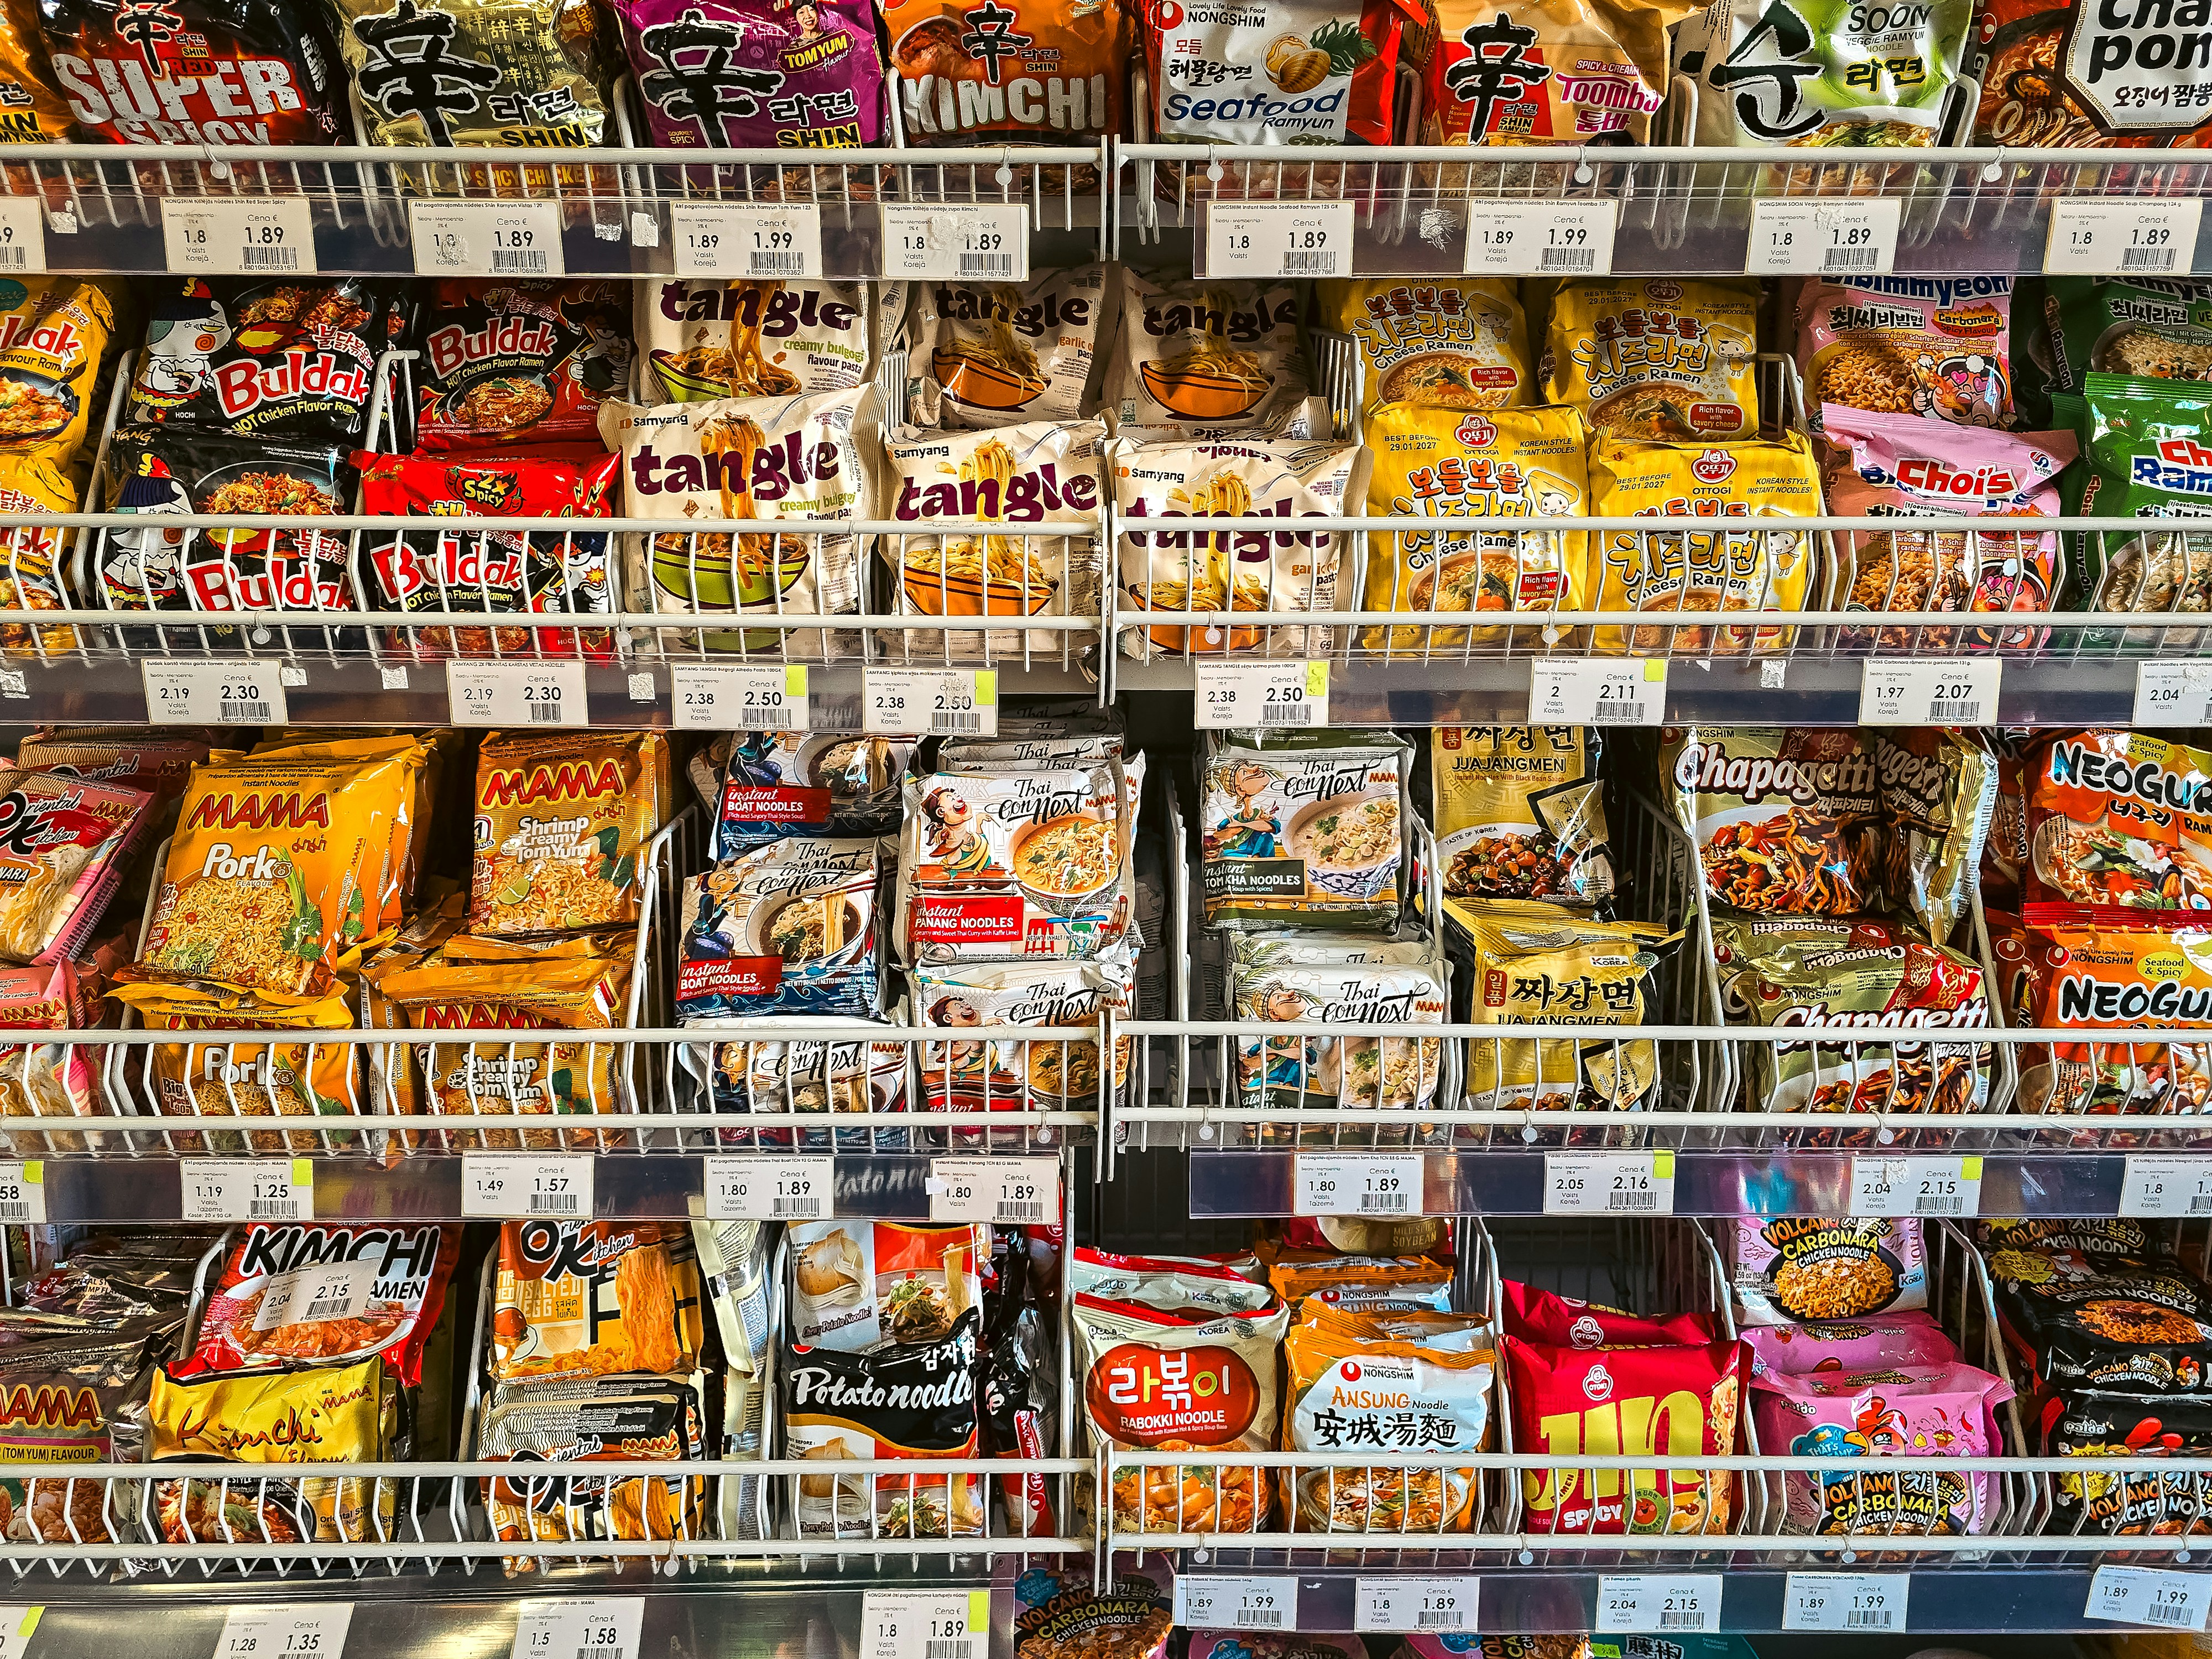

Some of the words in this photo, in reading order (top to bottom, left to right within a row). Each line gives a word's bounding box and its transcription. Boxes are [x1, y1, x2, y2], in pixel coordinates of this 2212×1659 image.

[1188, 11, 1266, 28] NONGSHIM
[1848, 3, 1934, 34] SOON
[962, 2, 1032, 85] 辛
[1846, 33, 1881, 47] VEGGIE
[1883, 30, 1924, 43] RAMYUN
[182, 47, 208, 57] SHIN
[1175, 39, 1203, 54] 모듬
[1866, 43, 1903, 54] NOODLE
[167, 58, 219, 75] RED
[1026, 62, 1057, 72] SHIN
[1169, 59, 1253, 87] 해물탕면
[1846, 55, 1927, 93] 라면
[53, 54, 305, 124] SUPER
[1555, 72, 1660, 113] Toomba
[2112, 85, 2169, 108] 오징어
[904, 74, 1105, 134] KIMCHI
[1164, 88, 1346, 121] Seafood
[1261, 116, 1334, 131] Ramyun
[1499, 116, 1533, 128] SHIN
[1575, 111, 1631, 133] 툼바
[1498, 125, 1532, 135] RAMYUN
[670, 135, 695, 144] SPICY
[184, 230, 206, 243] 1.8
[245, 227, 284, 243] 1.89
[494, 231, 533, 247] 1.89
[754, 232, 792, 248] 1.99
[964, 234, 1001, 250] 1.89
[1288, 232, 1326, 248] 1.89
[1484, 231, 1513, 244] 1.89
[1548, 229, 1587, 245] 1.99
[1832, 228, 1870, 244] 1.89
[2072, 232, 2092, 244] 1.8
[2132, 229, 2169, 244] 1.89
[660, 280, 857, 337] tangle
[1647, 302, 1682, 311] OTTOGI
[1937, 311, 2000, 327] Carbonara
[427, 315, 556, 379] Buldak
[784, 340, 823, 353] creamy
[827, 341, 864, 361] bulgogi
[1572, 336, 1709, 383] 치즈라면
[215, 351, 371, 419] Buldak
[1590, 370, 1646, 399] Cheese
[1650, 368, 1702, 384] Ramen
[633, 415, 688, 427] Samyang
[1390, 442, 1437, 451] 29.01.2027
[1550, 437, 1572, 446] STYLE
[1544, 446, 1577, 455] NOODLES!
[631, 431, 839, 500] tangle
[1131, 468, 1185, 483] Samyang
[1896, 458, 2018, 497] Choi's
[465, 482, 503, 507] Spicy
[1692, 487, 1731, 495] OTTOGI
[160, 688, 189, 699] 2.19
[221, 686, 258, 699] 2.30
[524, 687, 561, 700] 2.30
[685, 693, 714, 704] 2.38
[745, 691, 781, 706] 2.50
[1266, 687, 1302, 702] 2.50
[1600, 685, 1635, 699] 2.11
[1876, 687, 1905, 698] 1.97
[1934, 685, 1973, 698] 2.07
[2150, 690, 2179, 701] 2.04
[935, 695, 971, 709] 2.50
[1453, 758, 1564, 771] JJAJANGMEN
[1676, 744, 1877, 805] Chapagetti
[269, 779, 300, 787] Noodles
[480, 760, 626, 808] MAMA
[1015, 779, 1052, 797] Thai
[185, 792, 332, 832] MAMA
[728, 802, 753, 811] BOAT
[756, 802, 803, 811] NOODLES
[519, 815, 589, 833] Shrimp
[522, 832, 580, 847] Creamy
[202, 844, 276, 879] Pork
[1225, 875, 1245, 886] KHA
[1250, 875, 1301, 886] NOODLES
[915, 918, 957, 928] PANANG
[961, 917, 1014, 928] NOODLES
[2072, 954, 2133, 966] NONGSHIM
[2145, 958, 2184, 968] Seafood
[2154, 968, 2183, 978] Spicy
[1511, 975, 1637, 1012] 짜장면
[535, 1178, 568, 1191] 1.57
[721, 1185, 747, 1195] 1.80
[777, 1181, 810, 1195] 1.89
[1365, 1178, 1399, 1191] 1.89
[1613, 1176, 1647, 1189] 2.16
[1863, 1180, 1891, 1194] 2.04
[1919, 1181, 1955, 1194] 2.15
[2145, 1183, 2162, 1194] 1.8
[196, 1186, 222, 1197] 1.19
[253, 1185, 288, 1198] 1.25
[1001, 1186, 1034, 1199] 1.89
[1783, 1228, 1879, 1260] CARBONARA
[315, 1284, 349, 1298] 2.15
[1342, 1290, 1390, 1300] NONGSHIM
[1108, 1352, 1230, 1412] 라볶이
[1364, 1369, 1415, 1380] NONGSHIM
[790, 1367, 885, 1407] Potato
[888, 1370, 972, 1408] noodle
[1332, 1387, 1409, 1409] ANSUNG
[1412, 1400, 1449, 1411] Noodle
[1120, 1413, 1173, 1429] RABOKKI
[1175, 1408, 1225, 1426] NOODLE
[51, 1447, 95, 1461] FLAVOUR
[1242, 1597, 1274, 1608] 1.99
[1423, 1598, 1455, 1609] 1.89
[1664, 1599, 1697, 1610] 2.15
[1854, 1596, 1884, 1608] 1.99
[584, 1628, 616, 1644] 1.58
[931, 1621, 964, 1637] 1.89
[286, 1634, 320, 1650] 1.35
